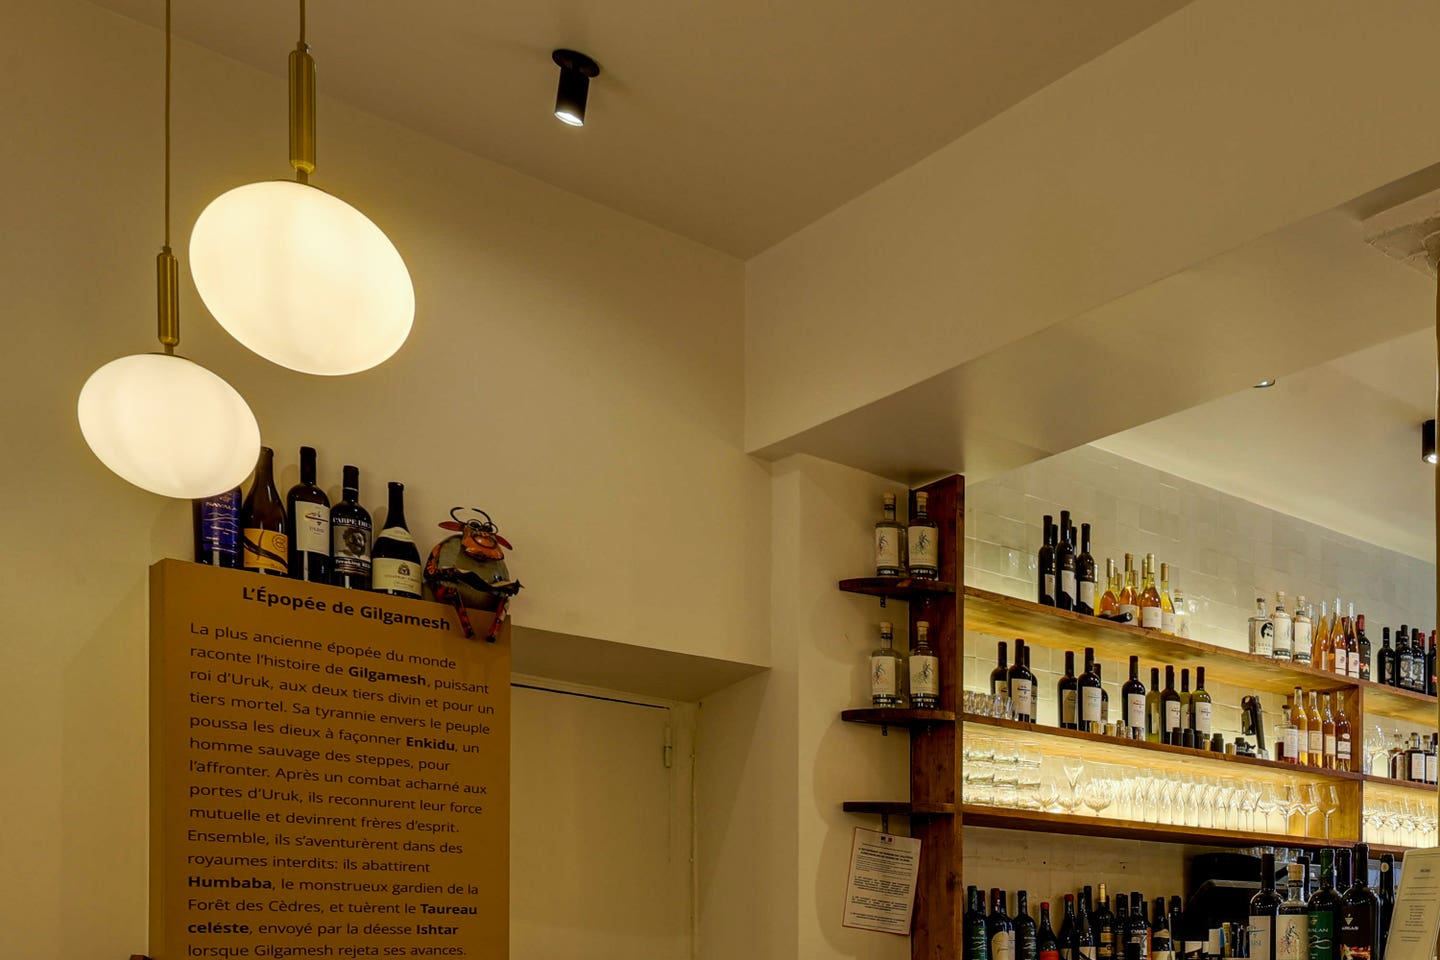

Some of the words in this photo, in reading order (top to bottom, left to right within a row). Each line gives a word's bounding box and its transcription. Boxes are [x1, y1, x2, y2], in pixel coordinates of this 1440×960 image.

[332, 601, 354, 616] de
[360, 605, 450, 631] Gilgamesh
[190, 622, 209, 635] La
[214, 626, 248, 640] plus
[252, 633, 322, 651] ancienne
[326, 641, 381, 659] épopée
[385, 649, 404, 662] du
[408, 655, 456, 669] monde
[190, 647, 251, 663] raconte
[324, 663, 343, 675] de
[348, 665, 430, 687] Gilgamesh,
[434, 679, 488, 694] puissant
[190, 670, 211, 681] roi
[278, 681, 307, 692] aux
[311, 683, 348, 697] deux
[352, 688, 384, 701] tiers
[388, 692, 421, 706] divin
[424, 698, 438, 708] et
[442, 701, 473, 712] pour
[477, 705, 494, 714] un
[189, 691, 225, 706] tiers
[230, 698, 287, 712] mortel.
[292, 702, 310, 715] Sa
[315, 706, 375, 722] tyrannie
[380, 714, 426, 727] envers
[430, 717, 441, 729] le
[446, 722, 490, 735] peuple
[190, 716, 247, 731] poussa
[253, 720, 274, 733] les
[279, 723, 320, 738] dieux
[325, 727, 333, 739] à
[338, 728, 401, 745] façonner
[406, 736, 457, 752] Enkidu,
[462, 744, 479, 753] un
[189, 736, 253, 754] homme
[258, 745, 320, 762] sauvage
[324, 749, 351, 762] des
[355, 754, 413, 768] steppes,
[418, 760, 450, 771] pour
[274, 767, 319, 782] Après
[324, 773, 343, 783] un
[347, 775, 401, 788] combat
[405, 778, 459, 792] acharné
[463, 784, 486, 794] aux
[189, 785, 242, 798] portes
[308, 791, 323, 803] ils
[328, 795, 416, 810] reconnurent
[420, 799, 445, 811] leur
[450, 801, 482, 814] force
[189, 808, 261, 821] mutuelle
[265, 812, 280, 822] et
[285, 812, 356, 827] devinrent
[360, 816, 402, 829] frères
[187, 829, 269, 845] Ensemble,
[274, 833, 290, 845] ils
[402, 840, 435, 852] dans
[439, 842, 463, 854] des
[187, 855, 268, 868] royaumes
[272, 855, 338, 869] interdits:
[343, 858, 357, 870] ils
[361, 859, 430, 872] abattirent
[188, 875, 275, 891] Humbaba,
[281, 878, 294, 890] le
[299, 881, 388, 892] monstrueux
[391, 882, 443, 895] gardien
[447, 883, 464, 894] de
[467, 883, 478, 895] la
[188, 898, 230, 911] Forêt
[235, 899, 263, 911] des
[268, 899, 324, 913] Cèdres,
[329, 903, 344, 912] et
[348, 901, 400, 913] tuèrent
[404, 903, 416, 914] le
[419, 903, 478, 915] Taureau
[258, 922, 312, 937] envoyé
[317, 925, 342, 937] par
[346, 923, 358, 934] la
[363, 923, 412, 934] déesse
[416, 923, 459, 935] Ishtar
[188, 944, 249, 959] lorsque
[254, 944, 333, 959] Gilgamesh
[338, 944, 379, 958] rejeta
[383, 947, 406, 955] ses
[410, 947, 466, 955] avances.
